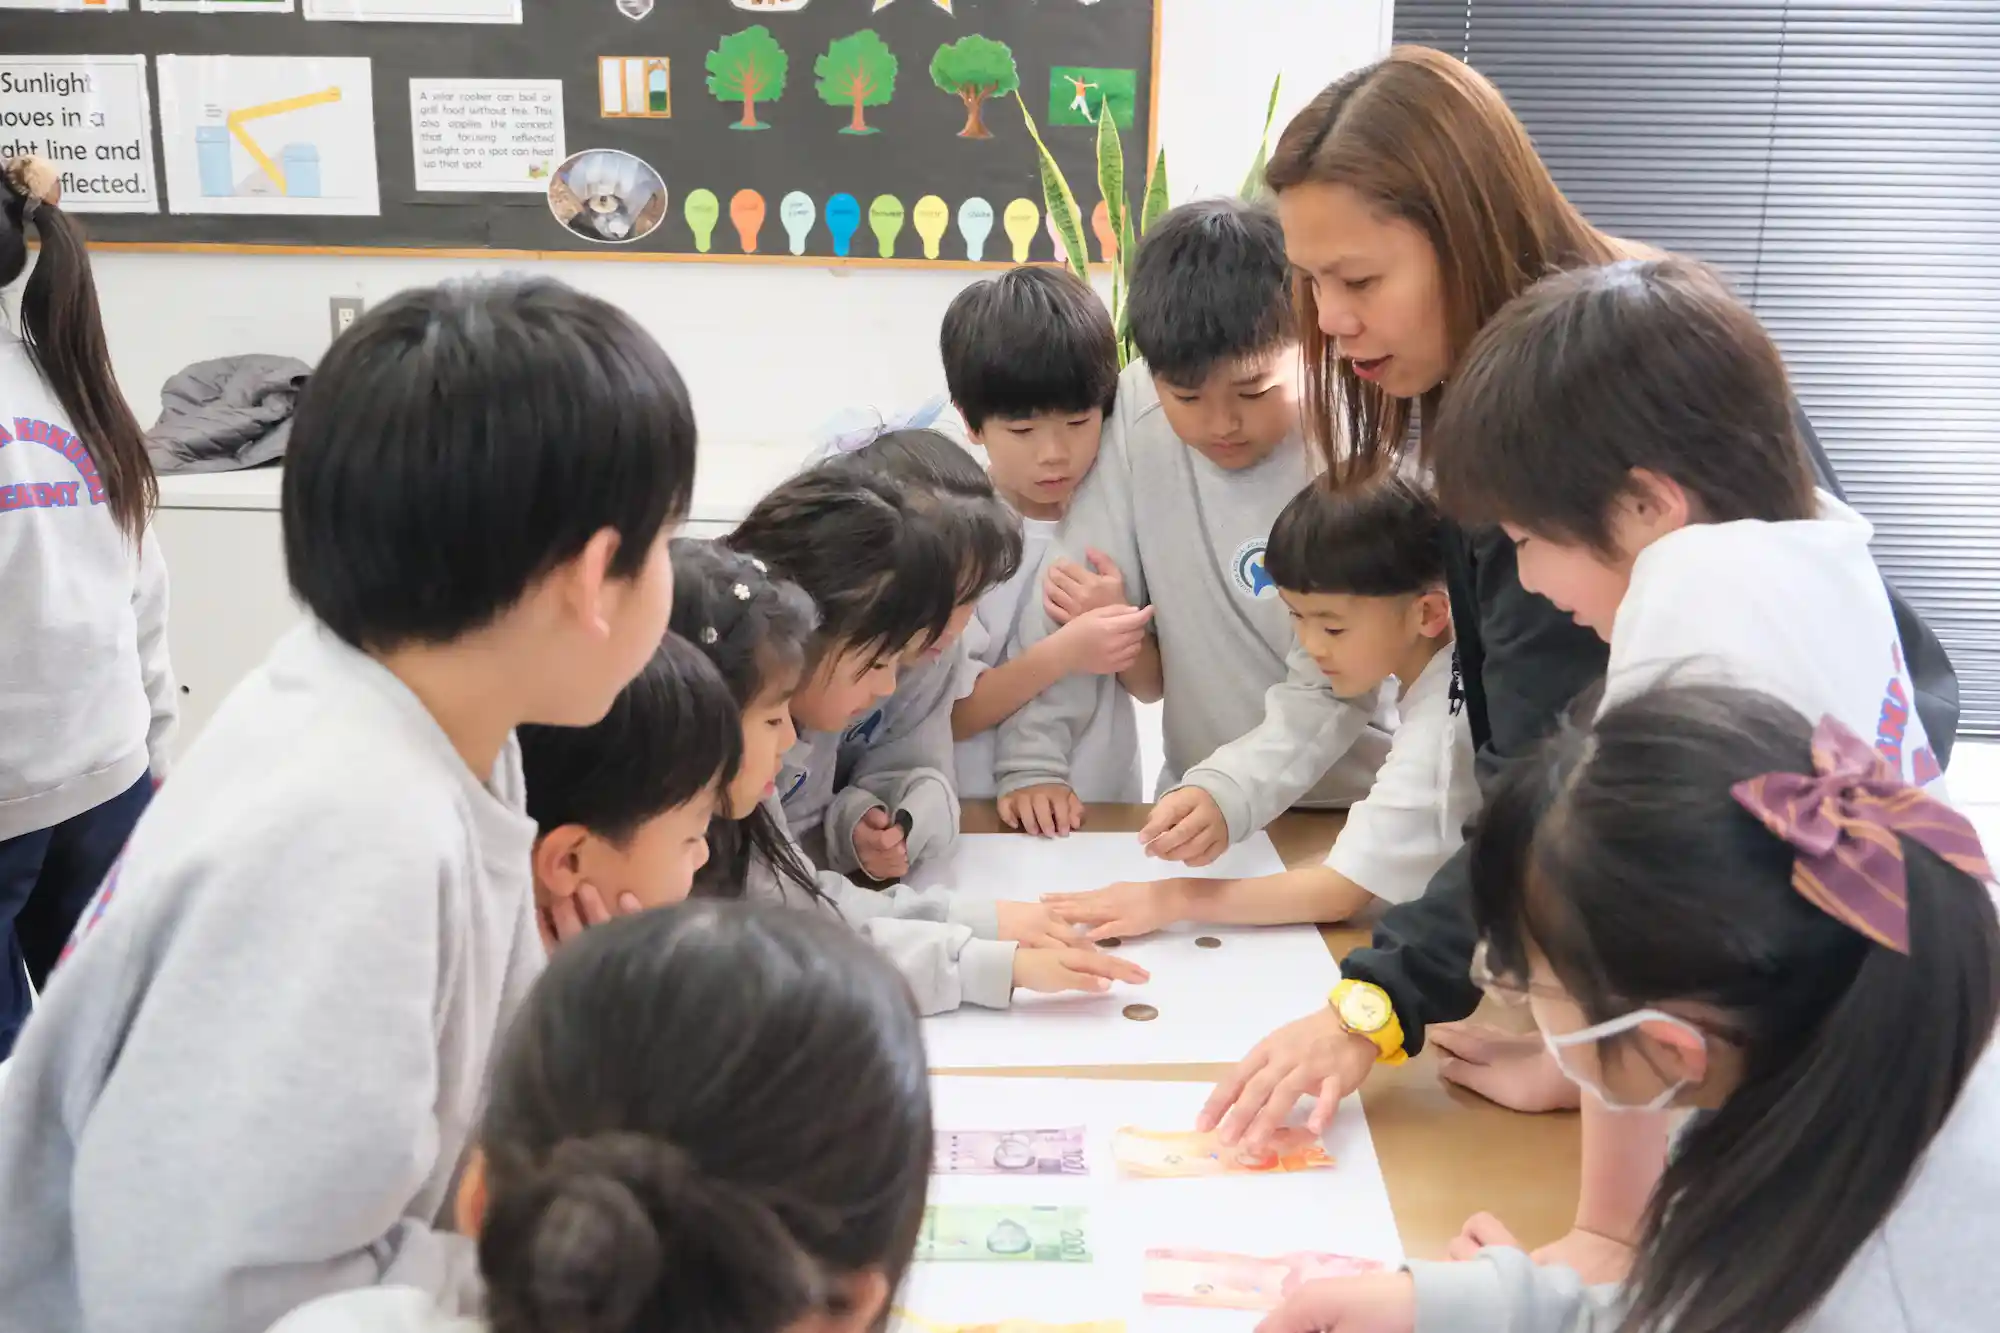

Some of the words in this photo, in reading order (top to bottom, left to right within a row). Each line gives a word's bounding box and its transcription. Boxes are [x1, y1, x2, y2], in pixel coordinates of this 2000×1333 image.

[1, 72, 94, 97] Sunlight
[496, 94, 514, 102] can
[0, 111, 54, 127] oves
[62, 107, 81, 127] in
[90, 112, 105, 127] a
[469, 105, 508, 115] without
[47, 139, 87, 160] line
[95, 139, 141, 160] and
[463, 147, 476, 156] on
[478, 147, 486, 156] a
[511, 147, 530, 156] can
[439, 159, 459, 169] that
[59, 172, 146, 194] flected.
